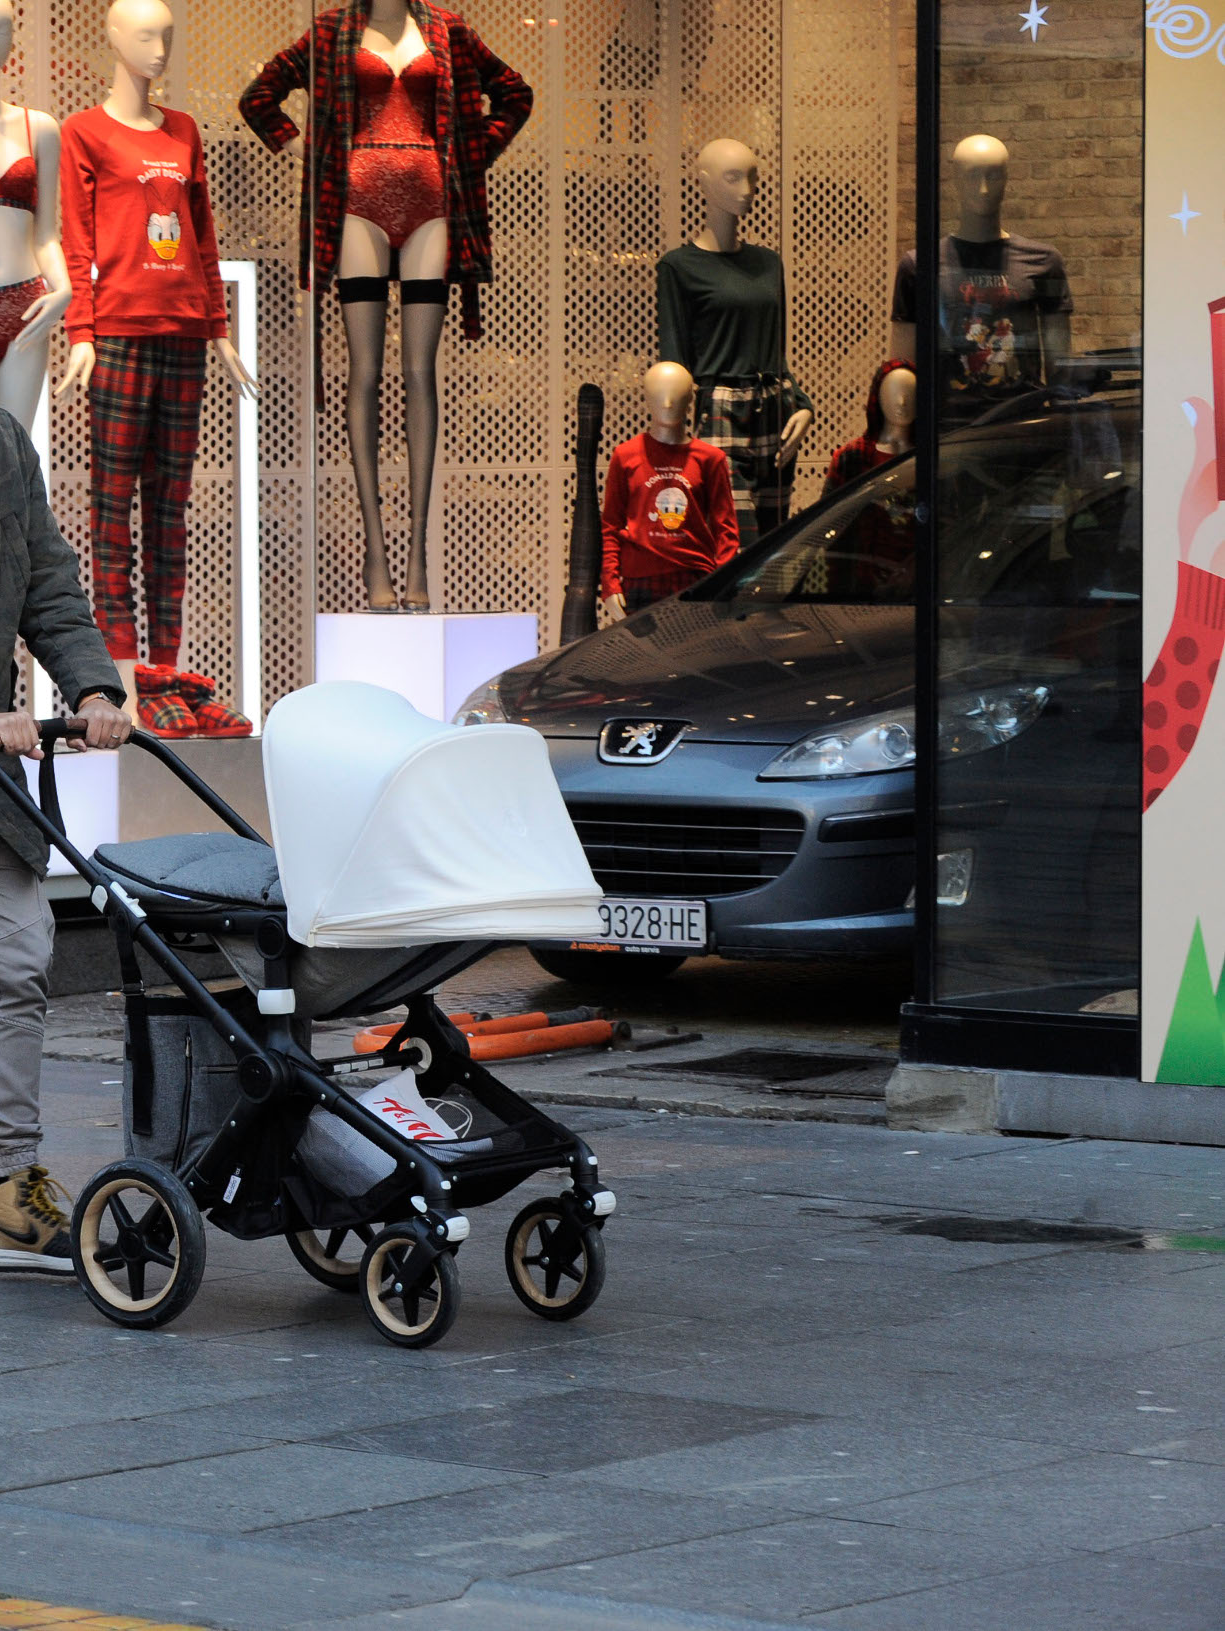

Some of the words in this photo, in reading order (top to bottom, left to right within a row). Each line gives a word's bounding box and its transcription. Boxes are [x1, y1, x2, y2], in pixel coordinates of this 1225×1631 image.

[137, 168, 161, 184] DAISY
[162, 168, 187, 185] DUCK
[645, 472, 674, 488] DONALD
[674, 473, 692, 489] DUCK
[641, 946, 661, 954] servis
[373, 1096, 446, 1140] H&M
